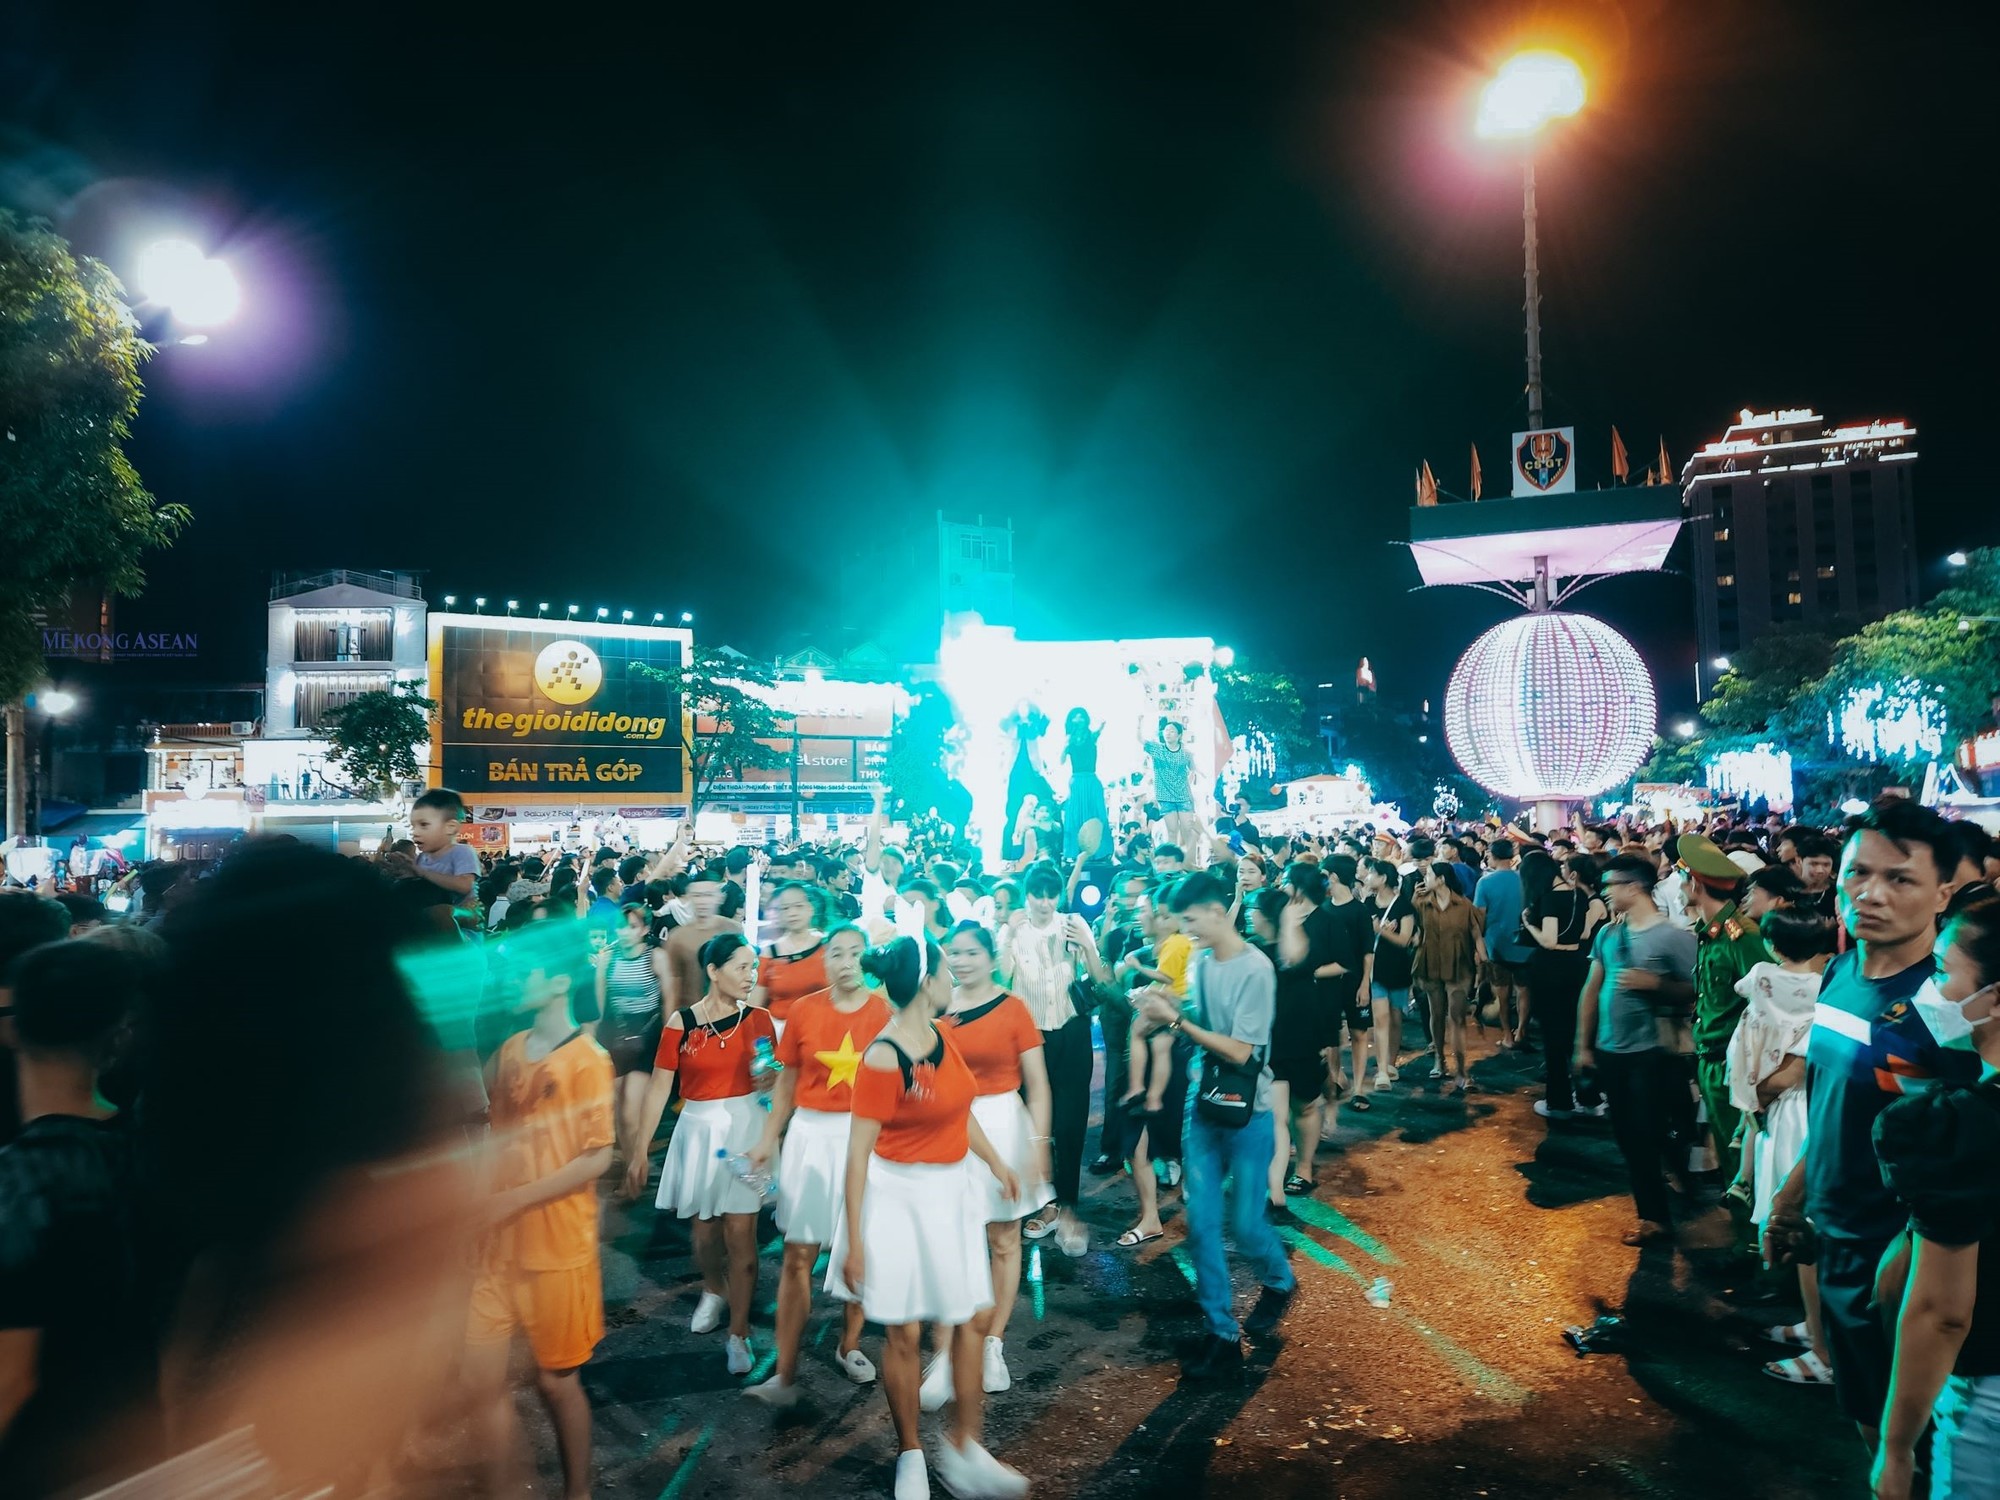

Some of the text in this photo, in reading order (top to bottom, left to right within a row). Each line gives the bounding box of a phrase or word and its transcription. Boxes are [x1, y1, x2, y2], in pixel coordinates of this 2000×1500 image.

[1524, 458, 1563, 470] CSGT
[462, 707, 666, 740] thegioididong
[812, 754, 848, 766] store
[488, 756, 643, 782] BÁN TRẢ GÓP
[523, 810, 550, 818] Galaxy
